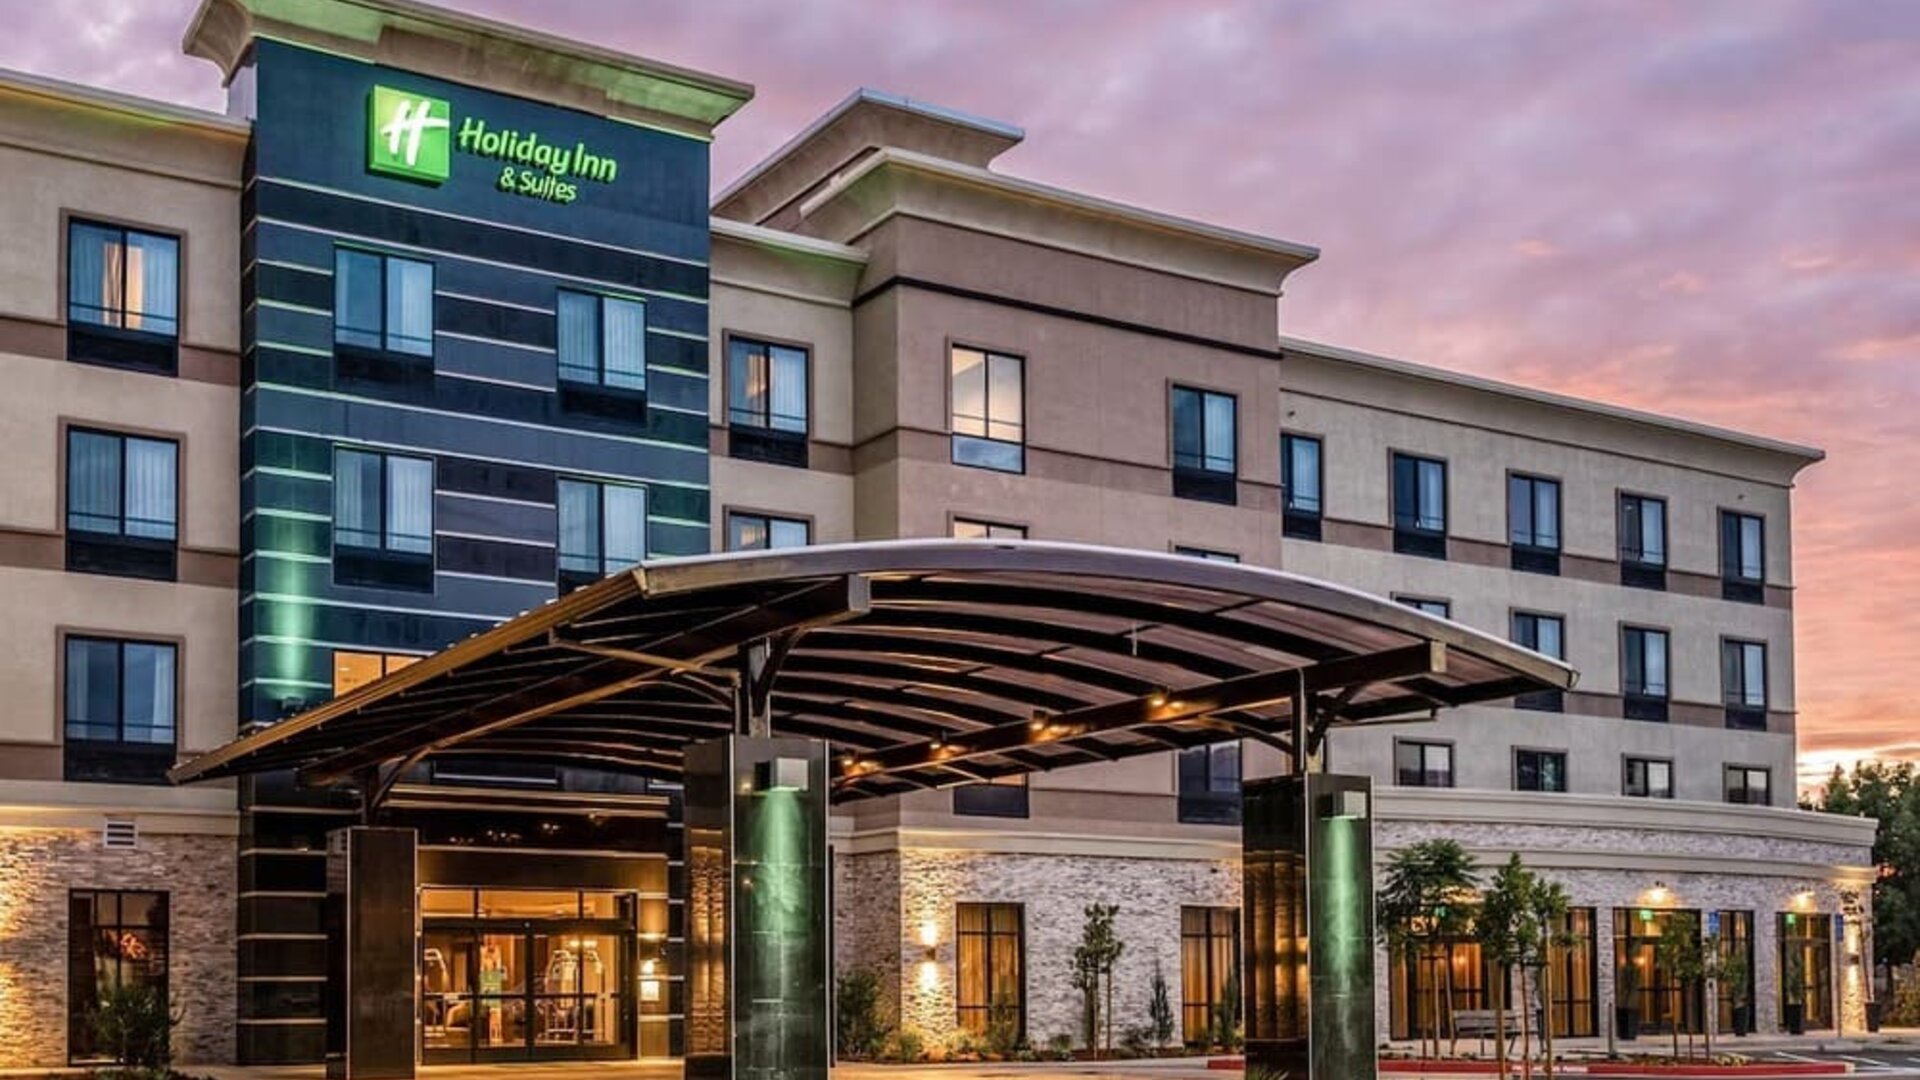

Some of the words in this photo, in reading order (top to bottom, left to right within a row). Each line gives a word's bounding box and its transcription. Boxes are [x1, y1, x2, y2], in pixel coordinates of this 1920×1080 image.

[380, 99, 450, 167] H
[458, 116, 571, 175] Holiday
[573, 142, 618, 182] Inn
[500, 166, 516, 188] &
[519, 170, 578, 202] Suites
